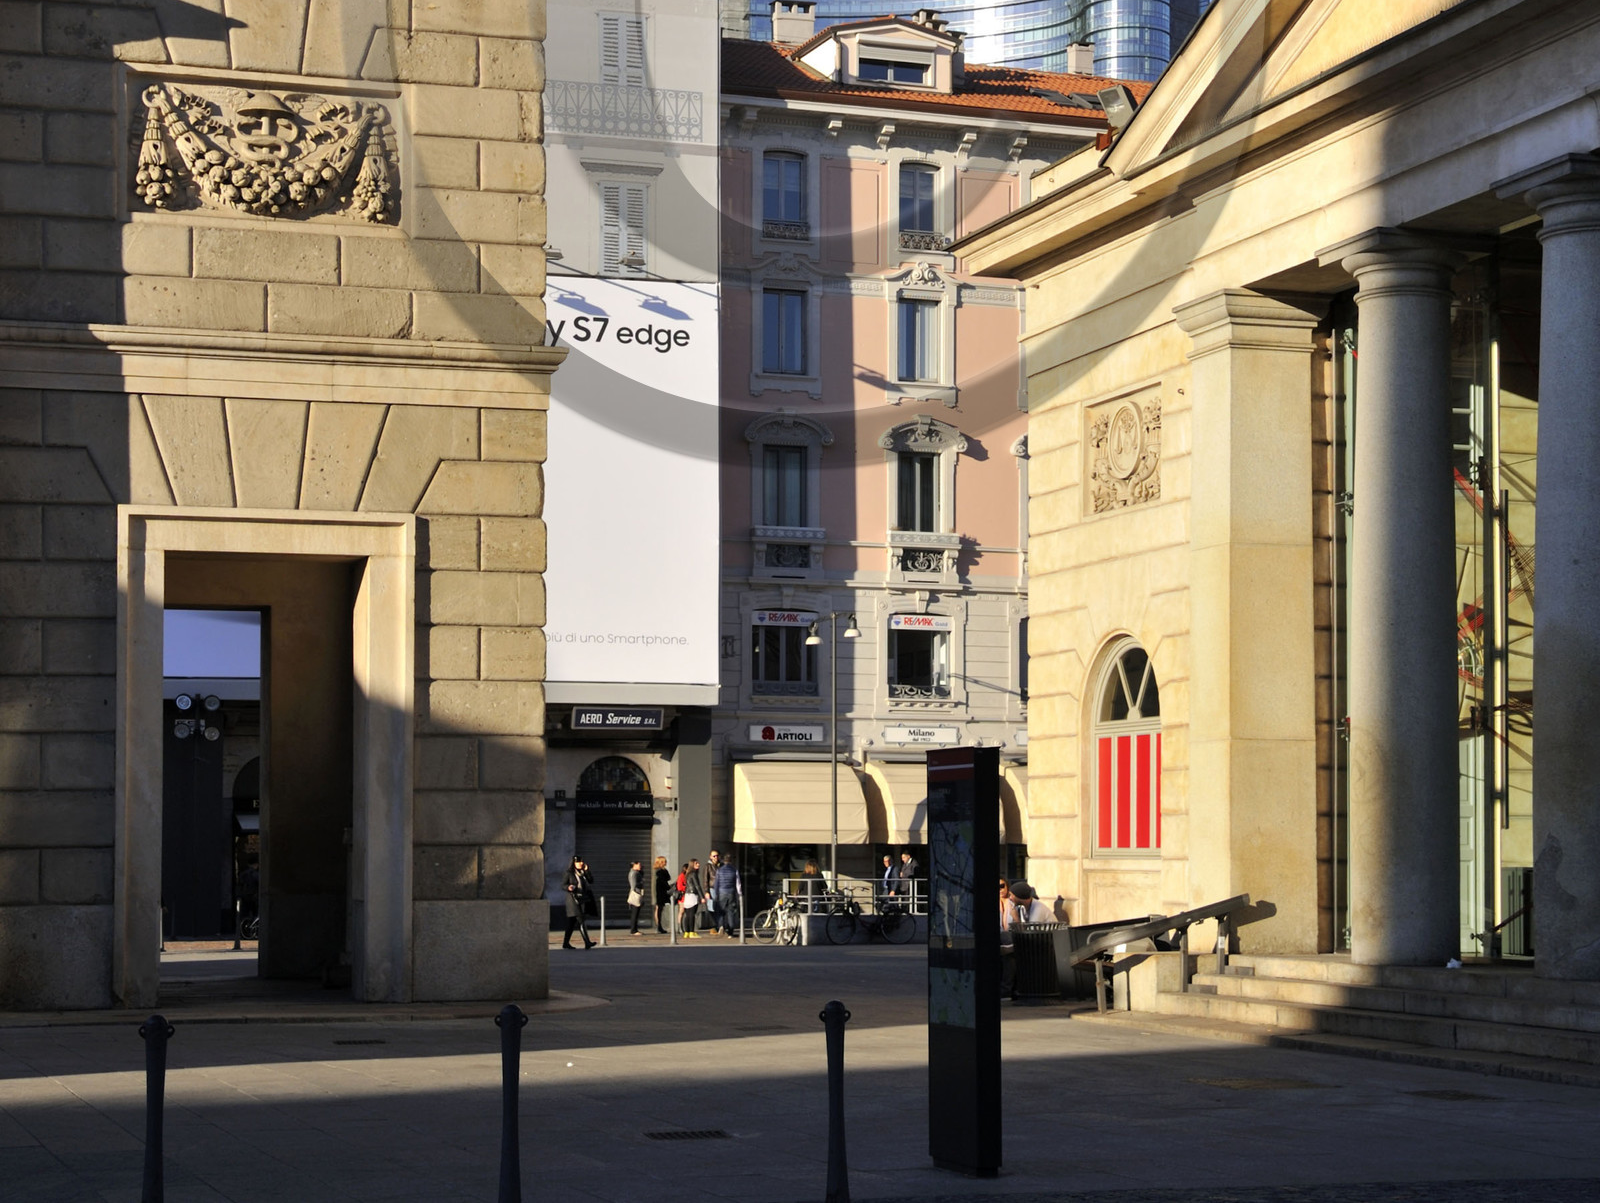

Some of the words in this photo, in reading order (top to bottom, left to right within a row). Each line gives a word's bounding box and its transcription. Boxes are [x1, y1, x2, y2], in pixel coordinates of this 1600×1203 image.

[573, 316, 609, 343] S7
[616, 324, 690, 353] edge
[768, 612, 799, 623] RE/MAX
[904, 616, 934, 626] RE/MAX
[565, 632, 577, 643] di
[580, 634, 605, 644] uno
[607, 633, 689, 647] Smartphone.
[580, 713, 602, 724] AERO
[606, 712, 641, 725] Service
[908, 729, 935, 737] Milano
